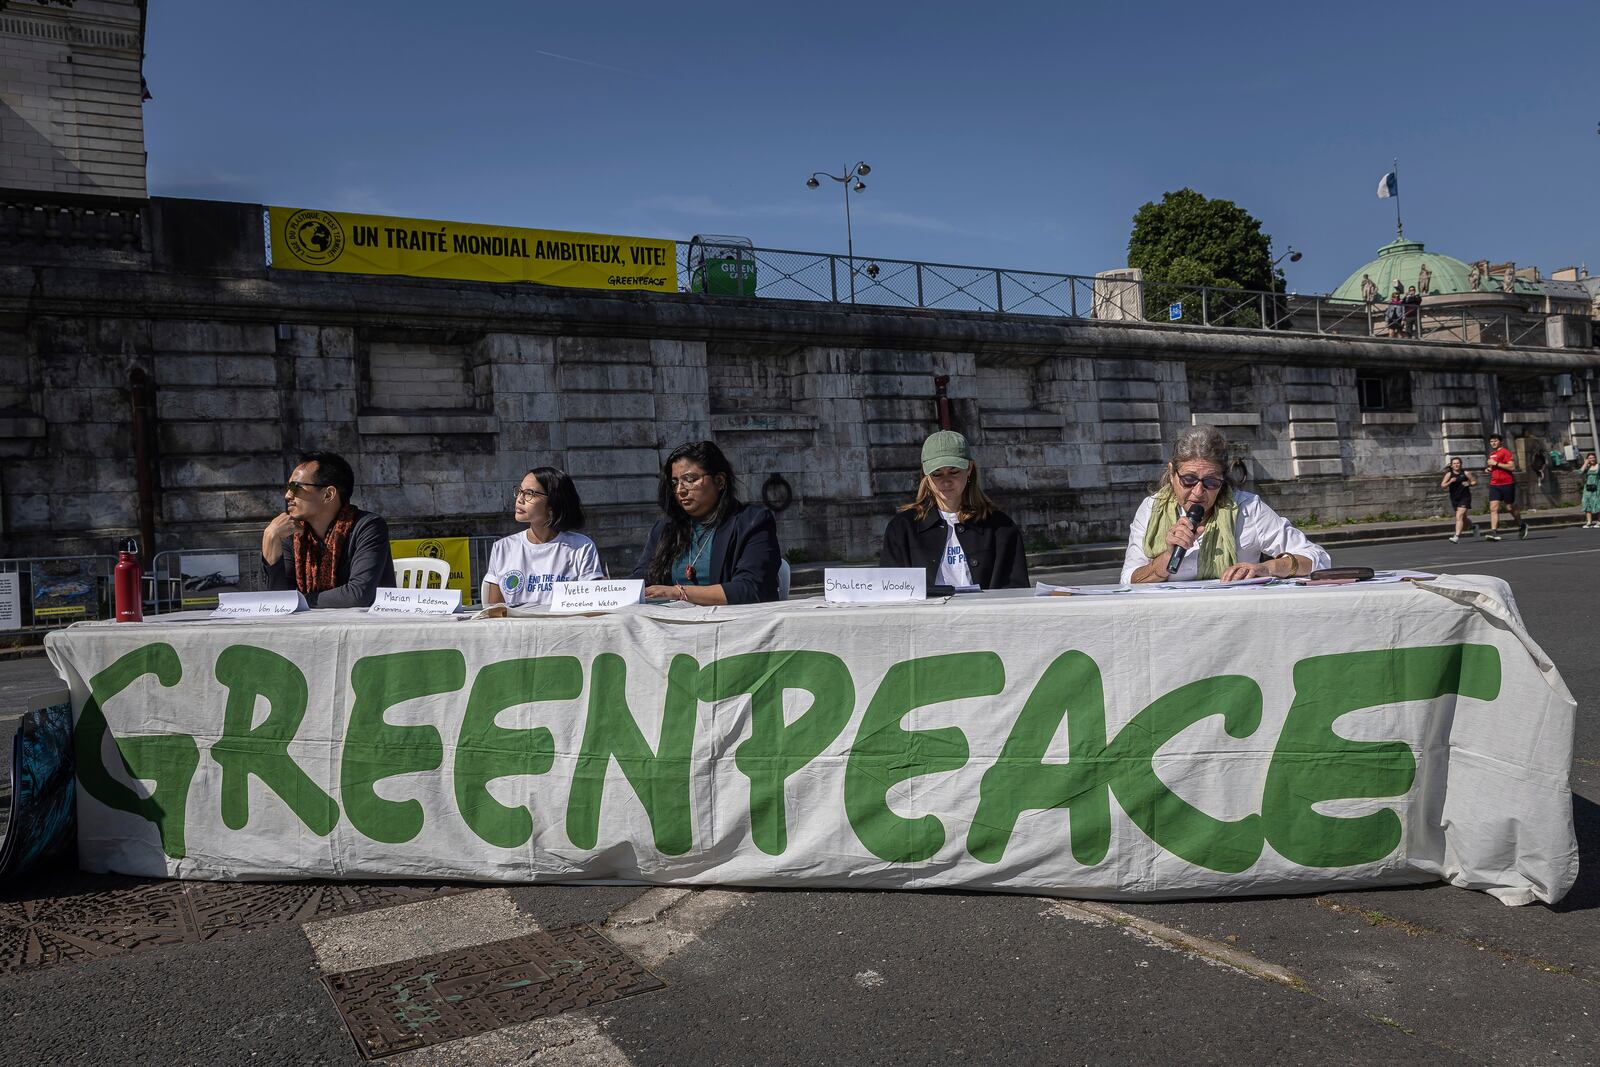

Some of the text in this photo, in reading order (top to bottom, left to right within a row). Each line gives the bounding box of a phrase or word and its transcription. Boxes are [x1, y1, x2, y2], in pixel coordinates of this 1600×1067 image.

[353, 225, 666, 267] UN TRAITÉ MONDIAL AMBITIEUX, VITE!
[721, 263, 754, 273] GREN
[608, 275, 667, 287] GREENPEACE
[947, 546, 961, 556] END
[947, 555, 957, 565] OF
[528, 575, 541, 584] END
[542, 574, 555, 583] THE
[527, 583, 553, 592] OF PLAS
[563, 584, 627, 596] Yvette Arellano
[825, 578, 916, 597] Shailene Woodley
[384, 591, 449, 606] Marian Ledesma
[258, 603, 271, 613] Von
[75, 642, 1501, 874] GREENPEACE
